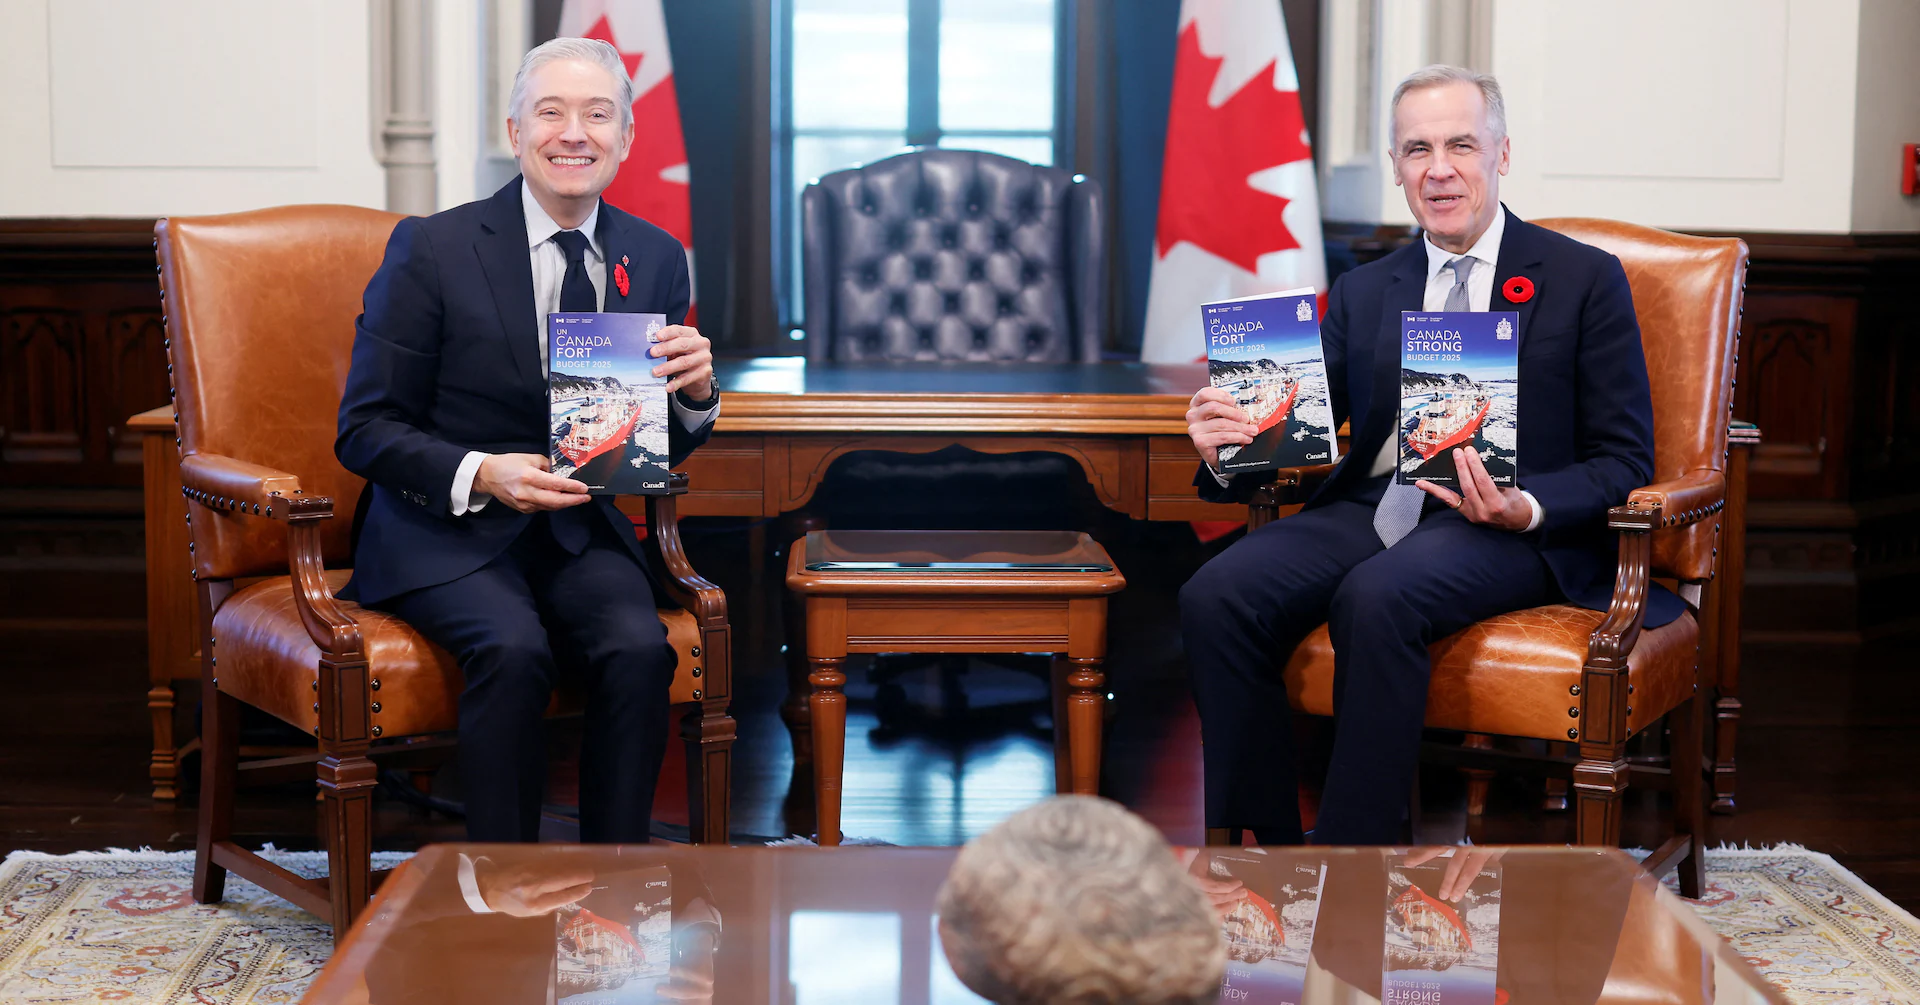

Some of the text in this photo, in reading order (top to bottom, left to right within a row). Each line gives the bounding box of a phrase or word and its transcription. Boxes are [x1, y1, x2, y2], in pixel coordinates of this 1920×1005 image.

[1210, 321, 1264, 334] CANADA
[1212, 334, 1245, 346] FORT
[1407, 330, 1462, 340] CANADA
[556, 336, 612, 346] CANADA
[1212, 344, 1265, 355] BUDGET 2025
[1407, 342, 1462, 352] STRONG
[556, 348, 592, 358] FORT
